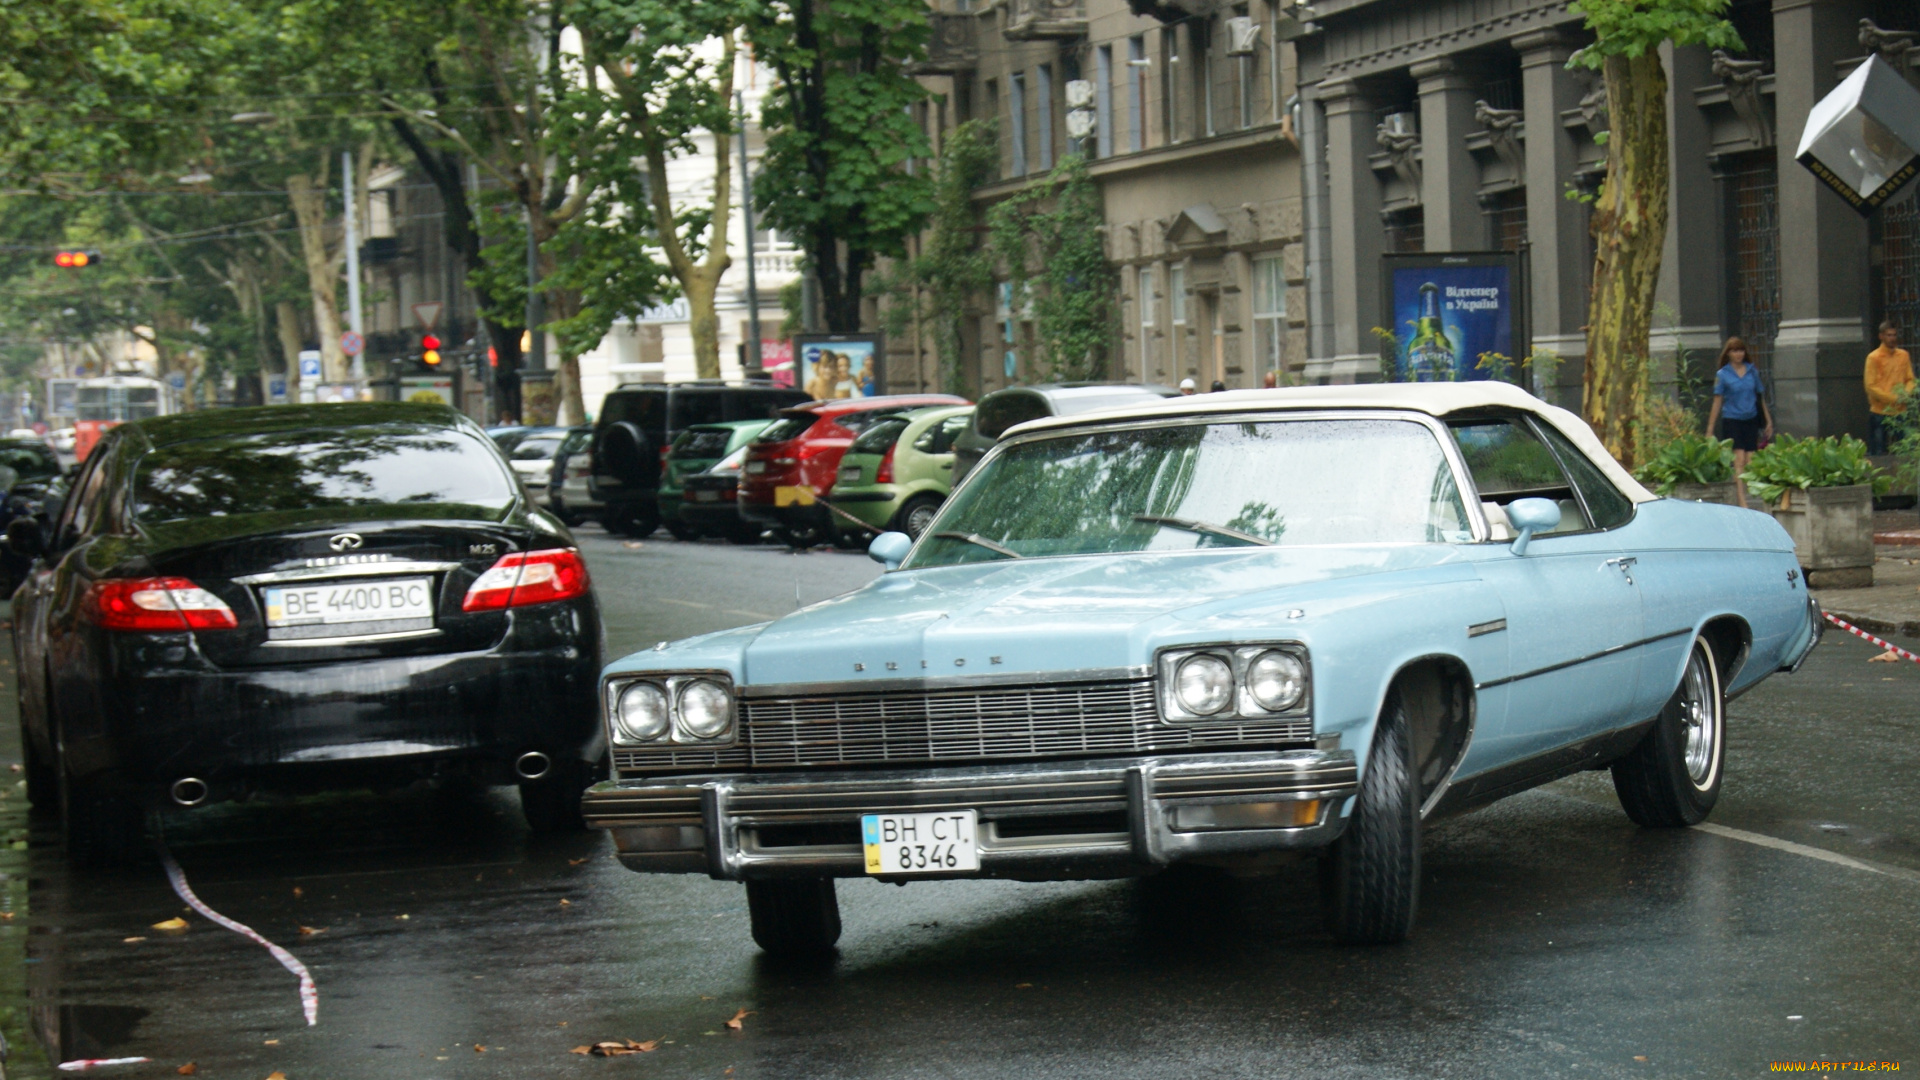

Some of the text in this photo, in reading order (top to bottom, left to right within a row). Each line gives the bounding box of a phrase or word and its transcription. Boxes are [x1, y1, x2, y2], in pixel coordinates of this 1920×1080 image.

[1446, 286, 1499, 299] Відтепер
[1446, 299, 1499, 312] в Україні
[469, 543, 496, 555] M25
[285, 591, 320, 615] BE
[328, 586, 382, 611] 4400
[388, 585, 424, 608] BC
[854, 655, 1003, 672] BUICK
[882, 816, 965, 843] BH CT
[867, 858, 880, 867] UA
[899, 843, 957, 869] 8346
